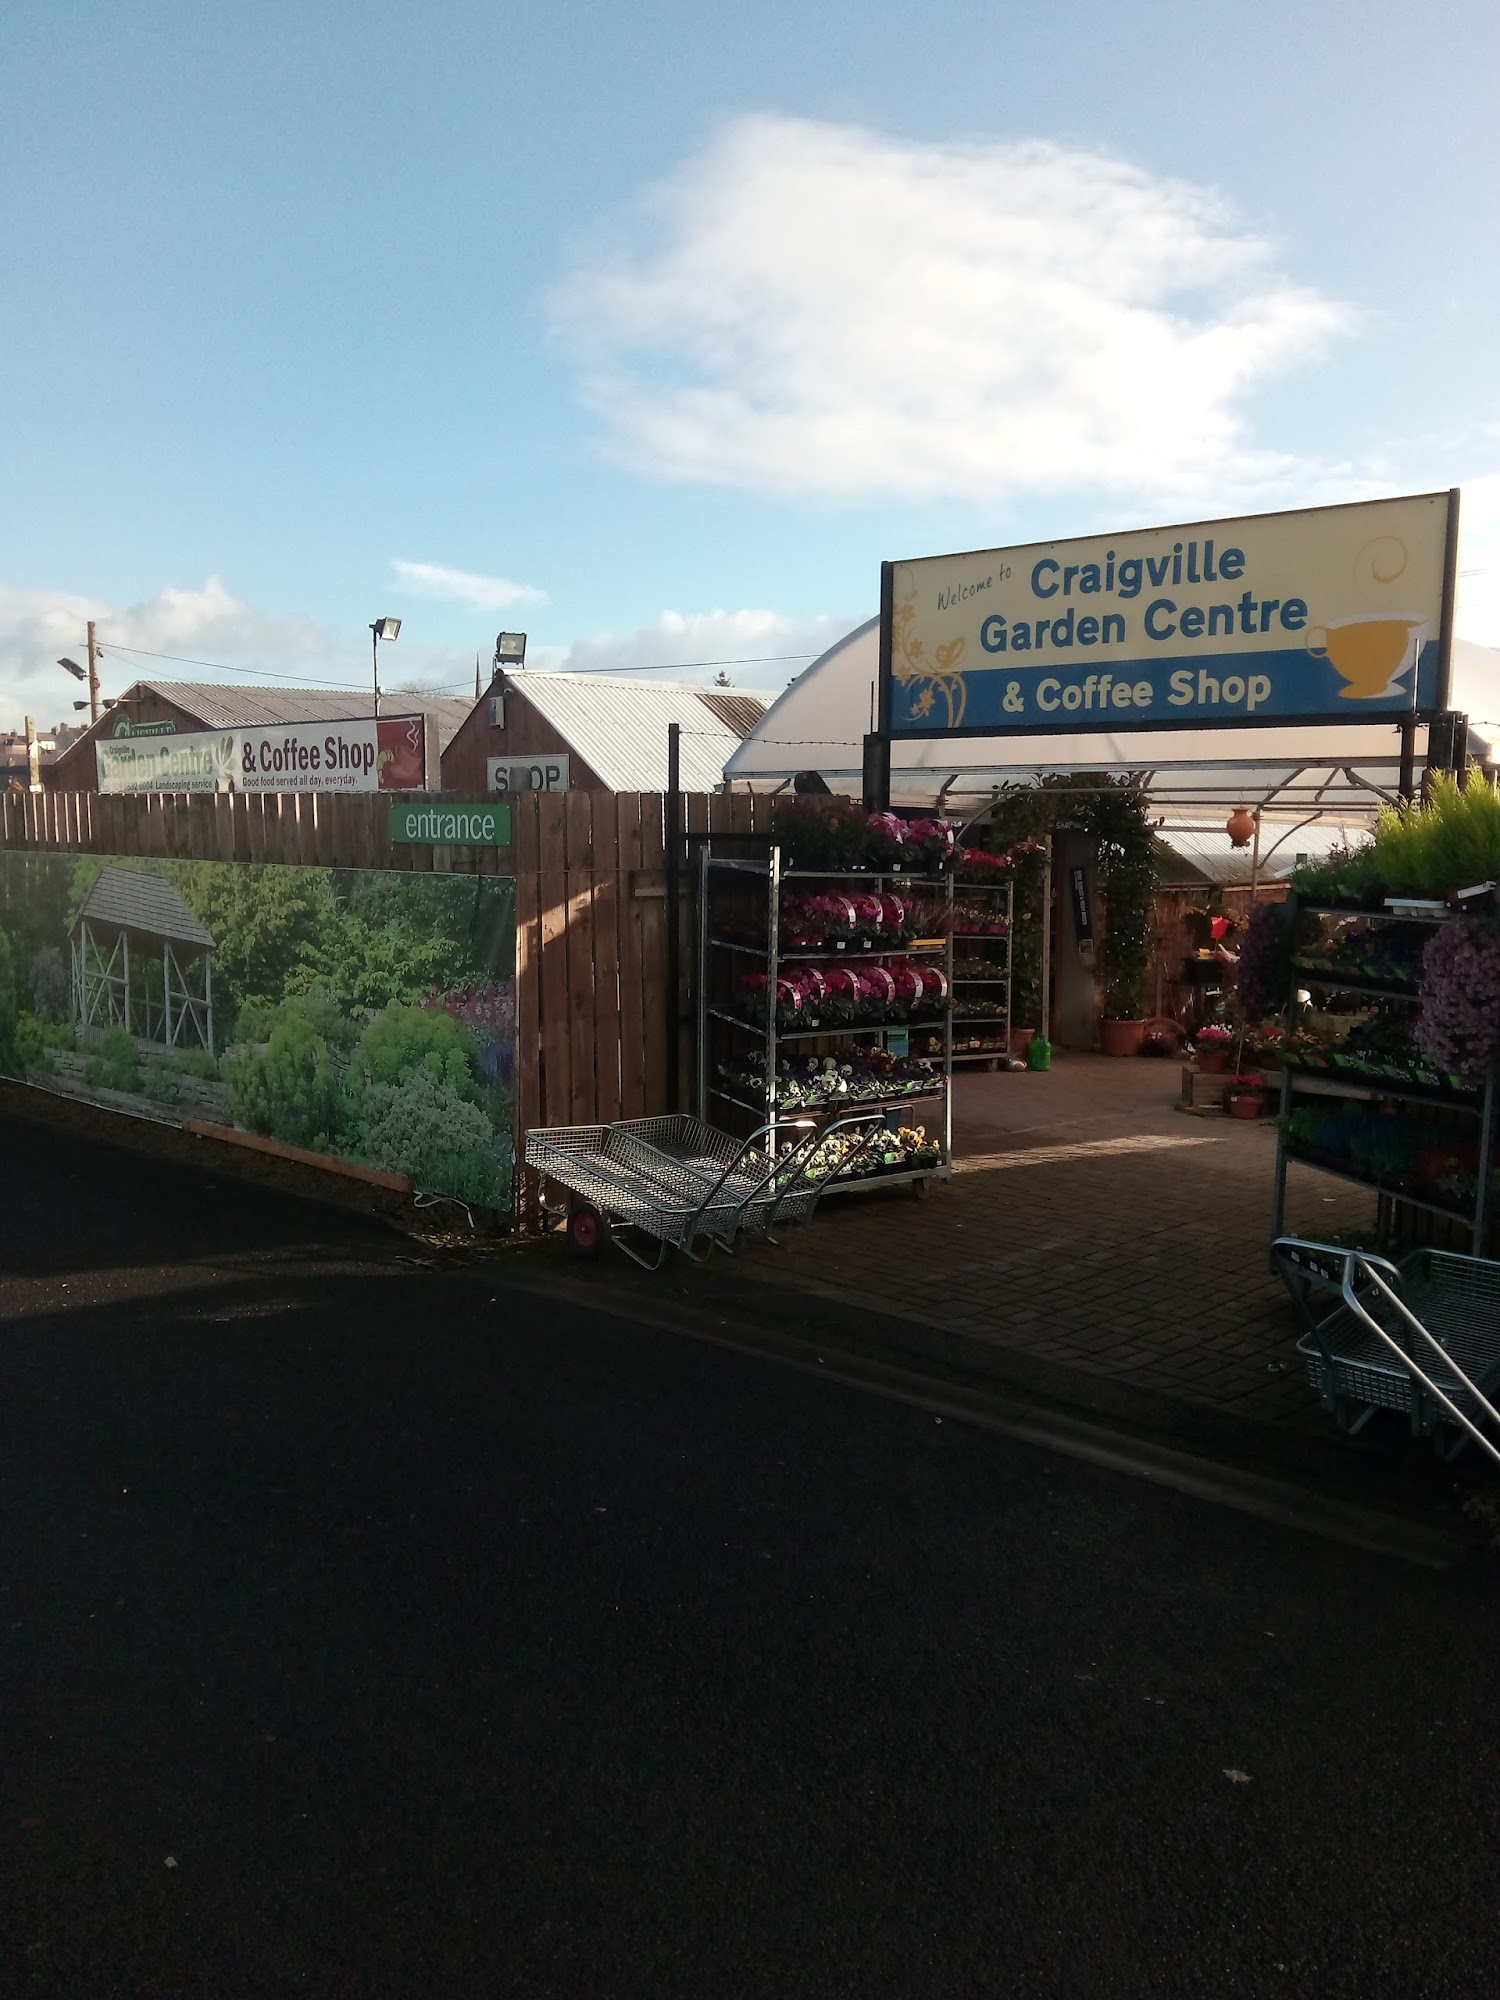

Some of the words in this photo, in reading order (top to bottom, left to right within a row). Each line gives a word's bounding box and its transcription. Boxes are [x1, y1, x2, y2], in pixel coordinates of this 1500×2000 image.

[937, 575, 992, 611] Welcome
[998, 563, 1013, 583] to
[1031, 541, 1246, 600] Craigville
[980, 608, 1126, 654] Garden
[1144, 591, 1307, 642] Centre
[1002, 683, 1024, 713] &
[1036, 674, 1154, 711] Coffee
[1167, 670, 1272, 711] Shop
[101, 749, 155, 779] Garden
[160, 746, 213, 776] Centre
[241, 742, 258, 773] &
[260, 739, 321, 771] Coffee
[325, 735, 375, 776] Shop
[495, 765, 560, 791] SOP
[156, 780, 190, 791] Landscaping
[191, 780, 212, 789] service
[242, 777, 259, 787] Good
[261, 777, 275, 786] food
[276, 776, 297, 786] served
[299, 776, 307, 786] all
[325, 773, 358, 787] everyday.
[405, 810, 495, 840] entrance
